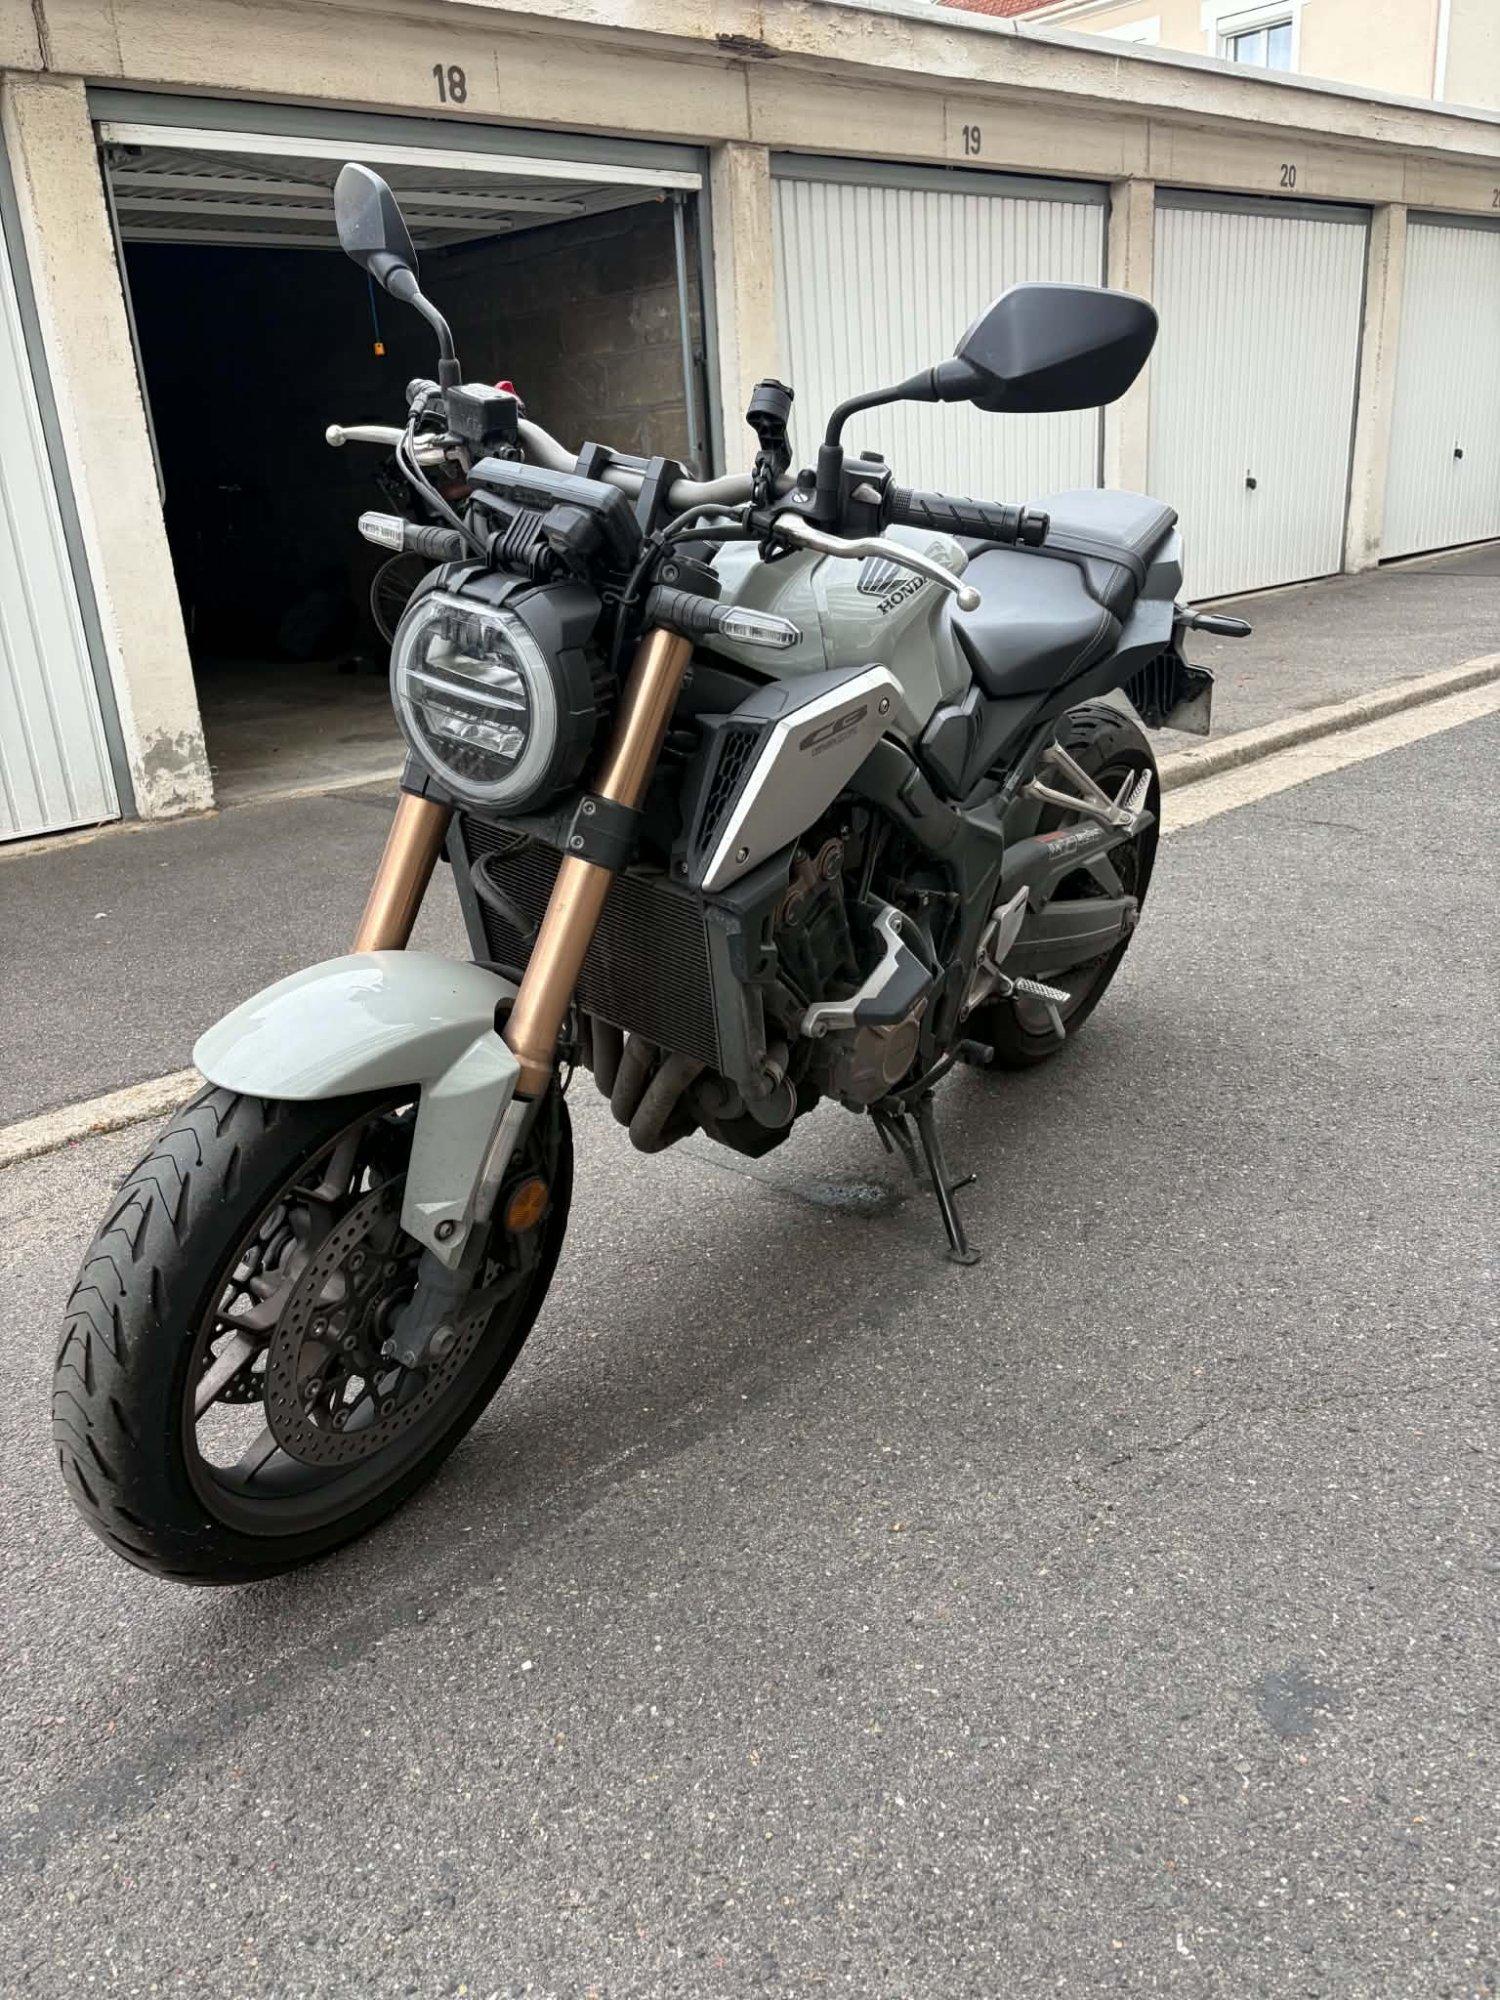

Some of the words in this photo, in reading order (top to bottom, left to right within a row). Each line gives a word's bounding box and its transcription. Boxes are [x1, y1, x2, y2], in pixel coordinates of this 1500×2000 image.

[433, 63, 467, 103] 18
[962, 124, 981, 155] 19
[1280, 163, 1296, 188] 20
[799, 704, 868, 751] CB
